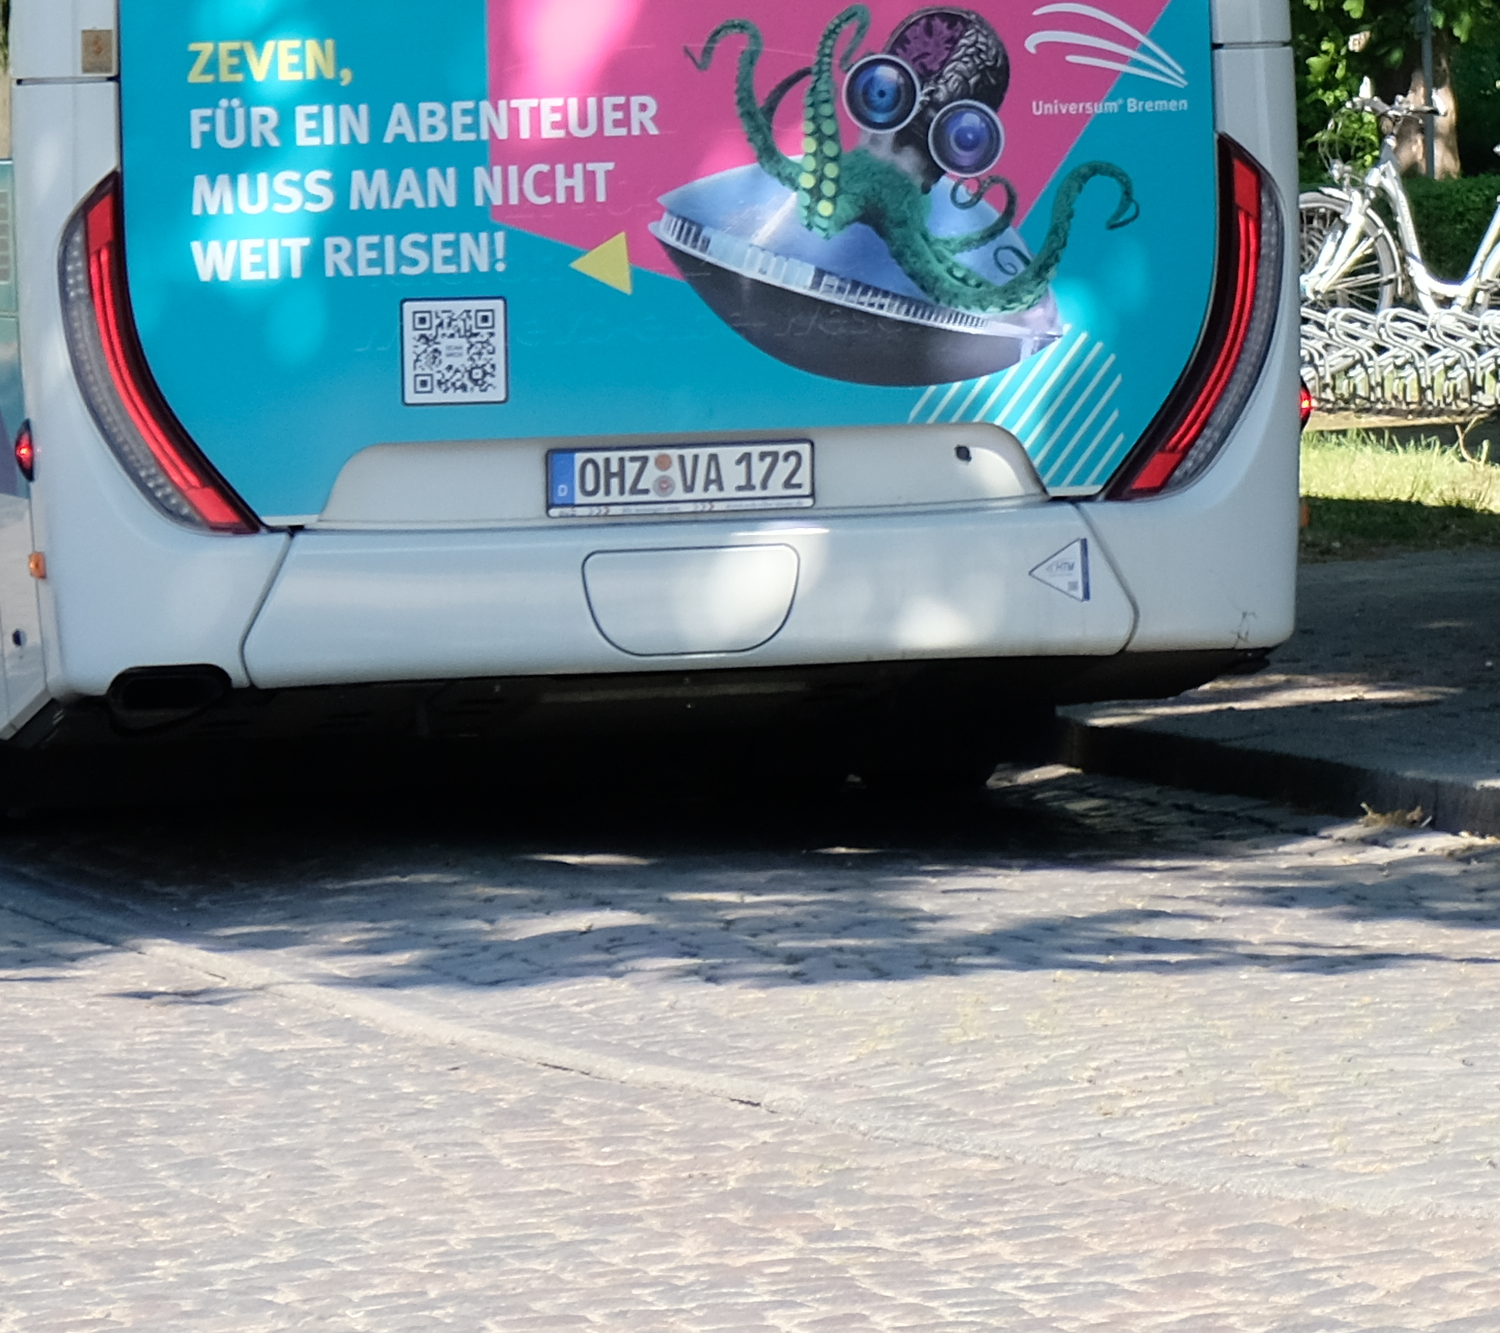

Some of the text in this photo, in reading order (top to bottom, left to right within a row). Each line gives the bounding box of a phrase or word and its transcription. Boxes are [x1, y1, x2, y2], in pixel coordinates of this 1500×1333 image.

[186, 38, 353, 86] ZEVEN,
[189, 95, 660, 149] FÜR EIN ABENTEUER
[1127, 98, 1188, 113] Bremen
[191, 162, 616, 216] MUSS MAN NICHT
[189, 231, 507, 282] WEIT REISEN!
[578, 455, 651, 497] OHZ
[678, 453, 725, 494] VA
[735, 450, 804, 492] 172
